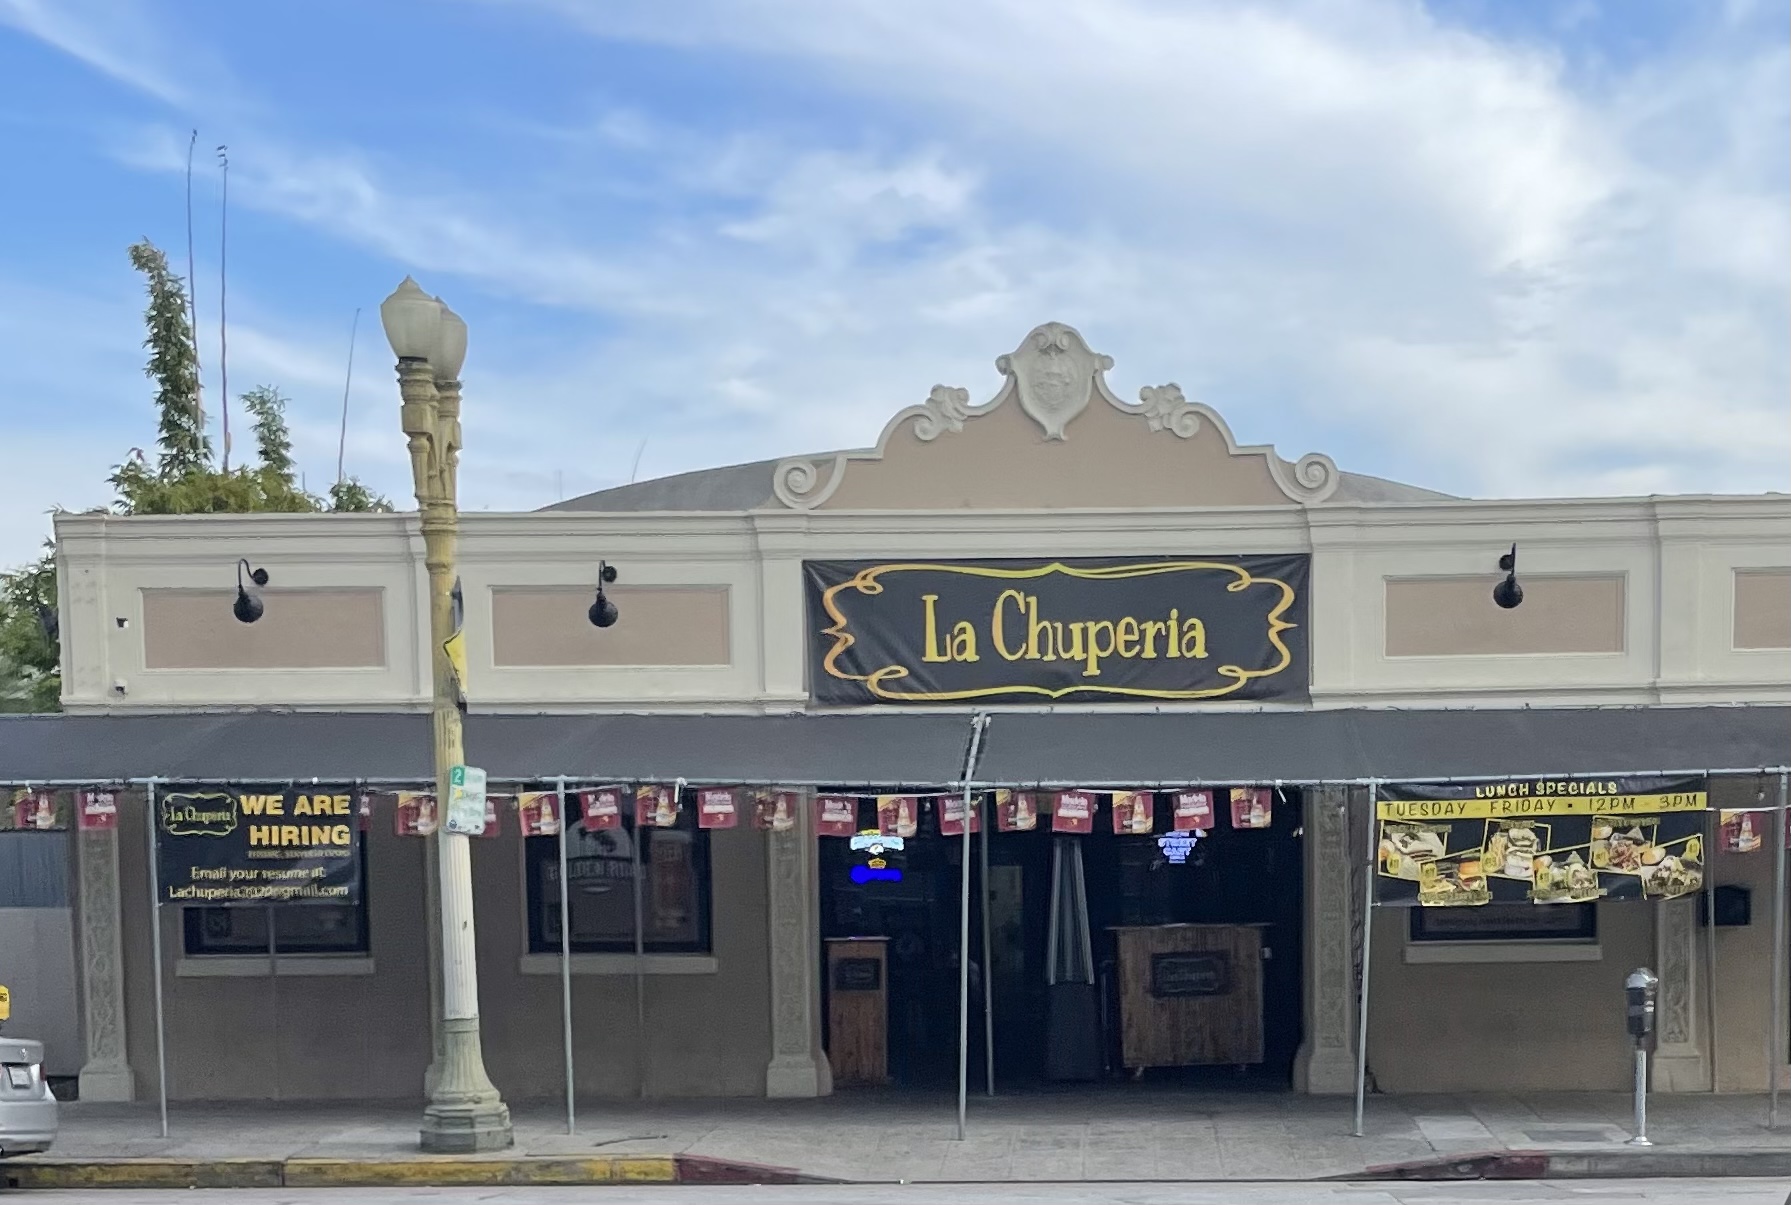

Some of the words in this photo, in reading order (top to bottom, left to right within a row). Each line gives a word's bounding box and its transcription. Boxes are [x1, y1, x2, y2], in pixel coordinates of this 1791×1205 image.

[921, 594, 980, 663] La
[991, 589, 1209, 677] Chuperia
[453, 768, 462, 784] 2
[1475, 784, 1529, 798] LUNCH
[1535, 781, 1618, 797] SPECIALS
[240, 794, 284, 815] WE
[294, 795, 351, 816] ARE
[1384, 802, 1467, 817] TUESDAY
[1490, 799, 1556, 814] FRIDAY
[1588, 797, 1636, 811] 12PM
[1659, 794, 1698, 809] 3PM
[249, 824, 350, 846] HIRING
[190, 866, 227, 879] Email
[229, 869, 258, 881] your
[261, 869, 309, 879] resume
